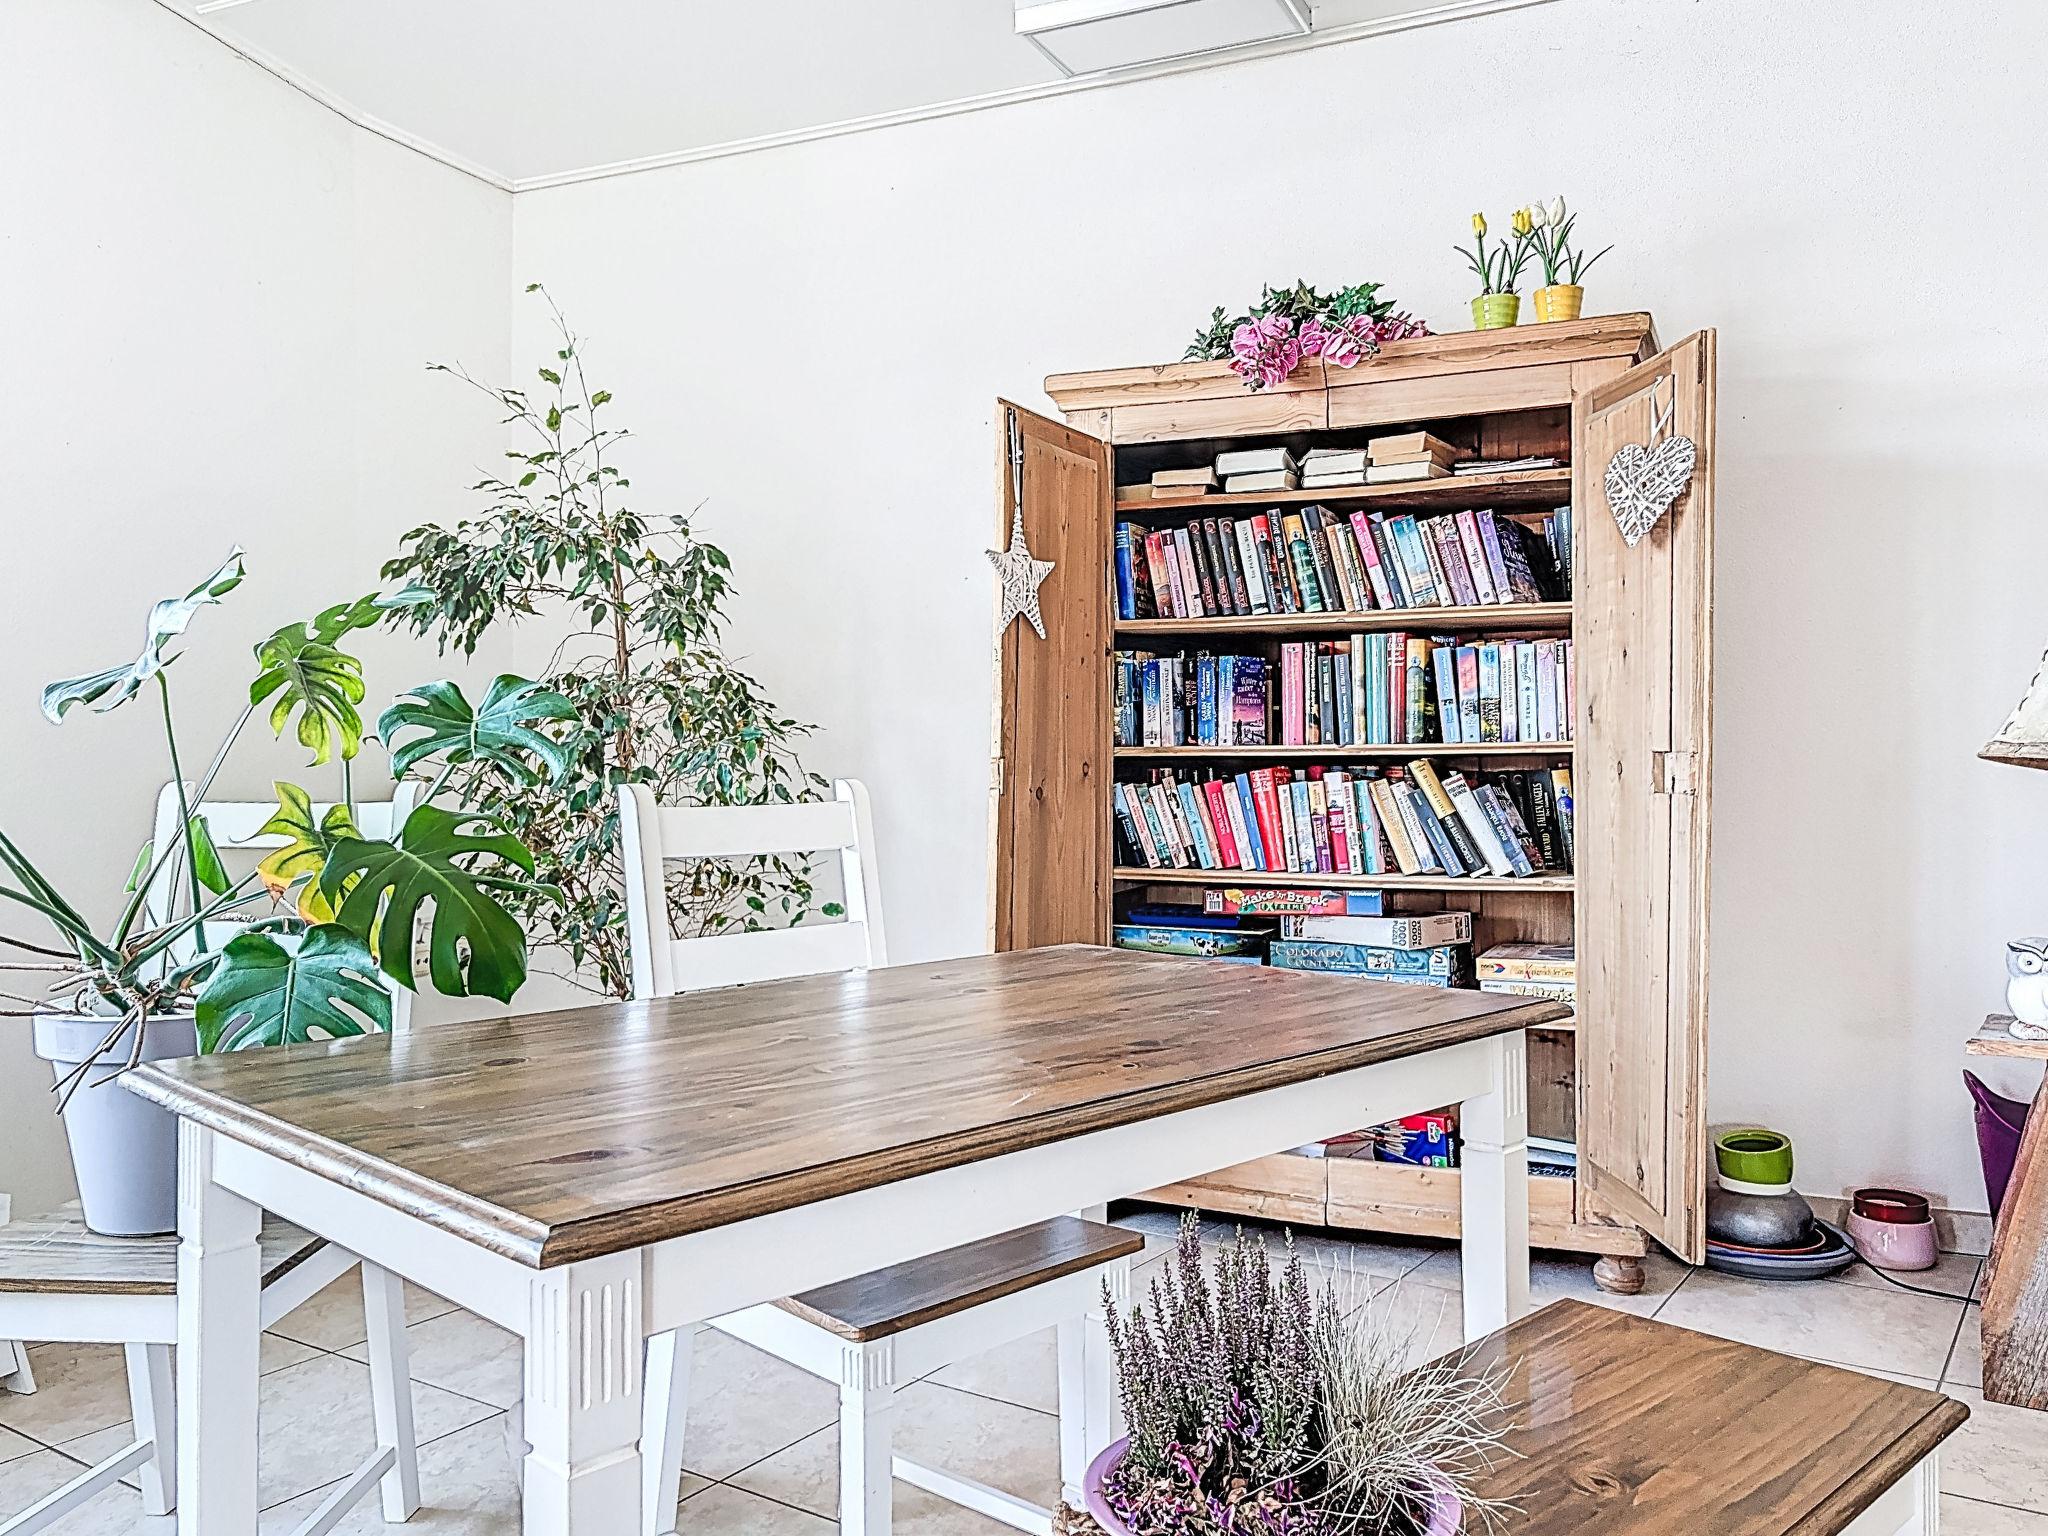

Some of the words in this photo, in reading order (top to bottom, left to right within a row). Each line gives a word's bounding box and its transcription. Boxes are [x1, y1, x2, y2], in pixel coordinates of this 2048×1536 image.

[1531, 782, 1545, 805] ANGELS
[1481, 801, 1500, 826] roberts
[1534, 804, 1548, 827] FALLEN
[1495, 825, 1508, 841] nora
[1240, 891, 1275, 906] Make
[1286, 890, 1328, 907] Break
[1398, 920, 1407, 946] 1000
[1275, 944, 1344, 958] COLORADO
[1286, 956, 1329, 968] COUNTY
